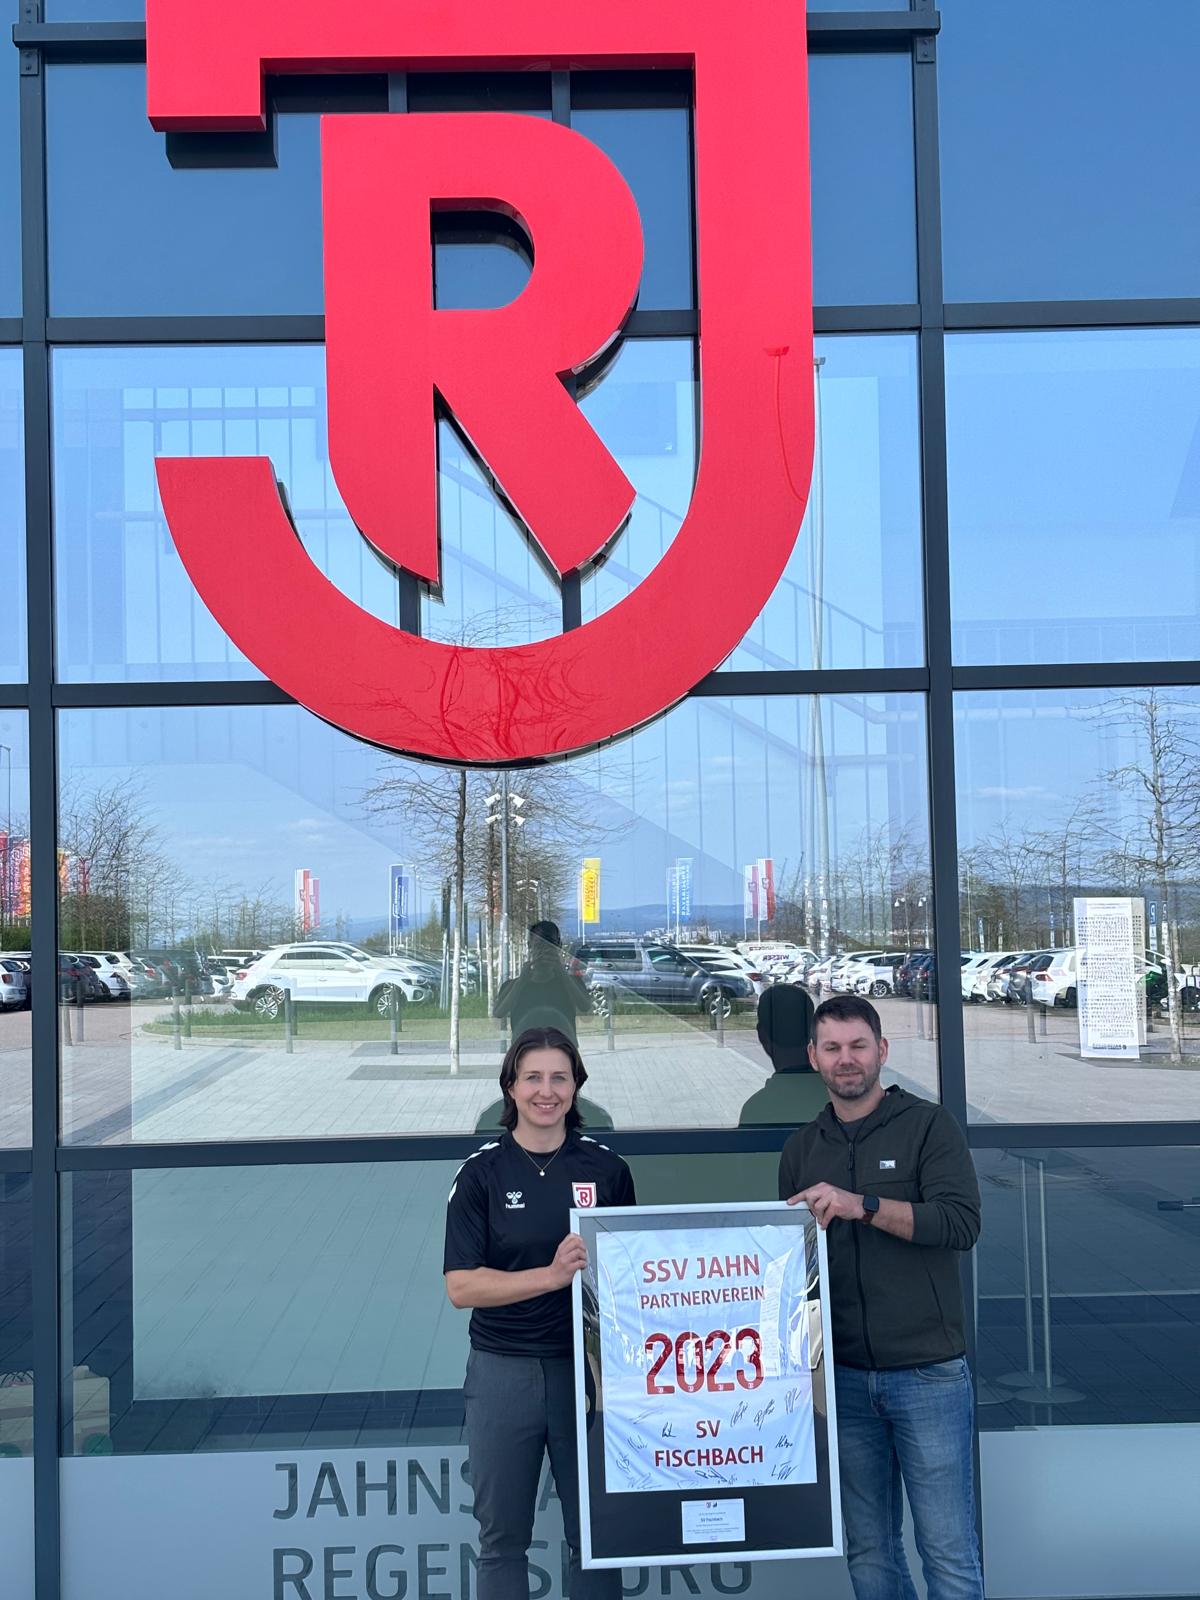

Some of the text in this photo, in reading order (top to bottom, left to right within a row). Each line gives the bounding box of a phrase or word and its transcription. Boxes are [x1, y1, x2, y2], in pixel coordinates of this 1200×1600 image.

[643, 1254, 760, 1283] SSV JAHN
[641, 1285, 766, 1310] PARTNERVEREIN
[645, 1328, 764, 1394] 2023
[696, 1420, 721, 1438] SV
[655, 1445, 764, 1468] FISCHBACH
